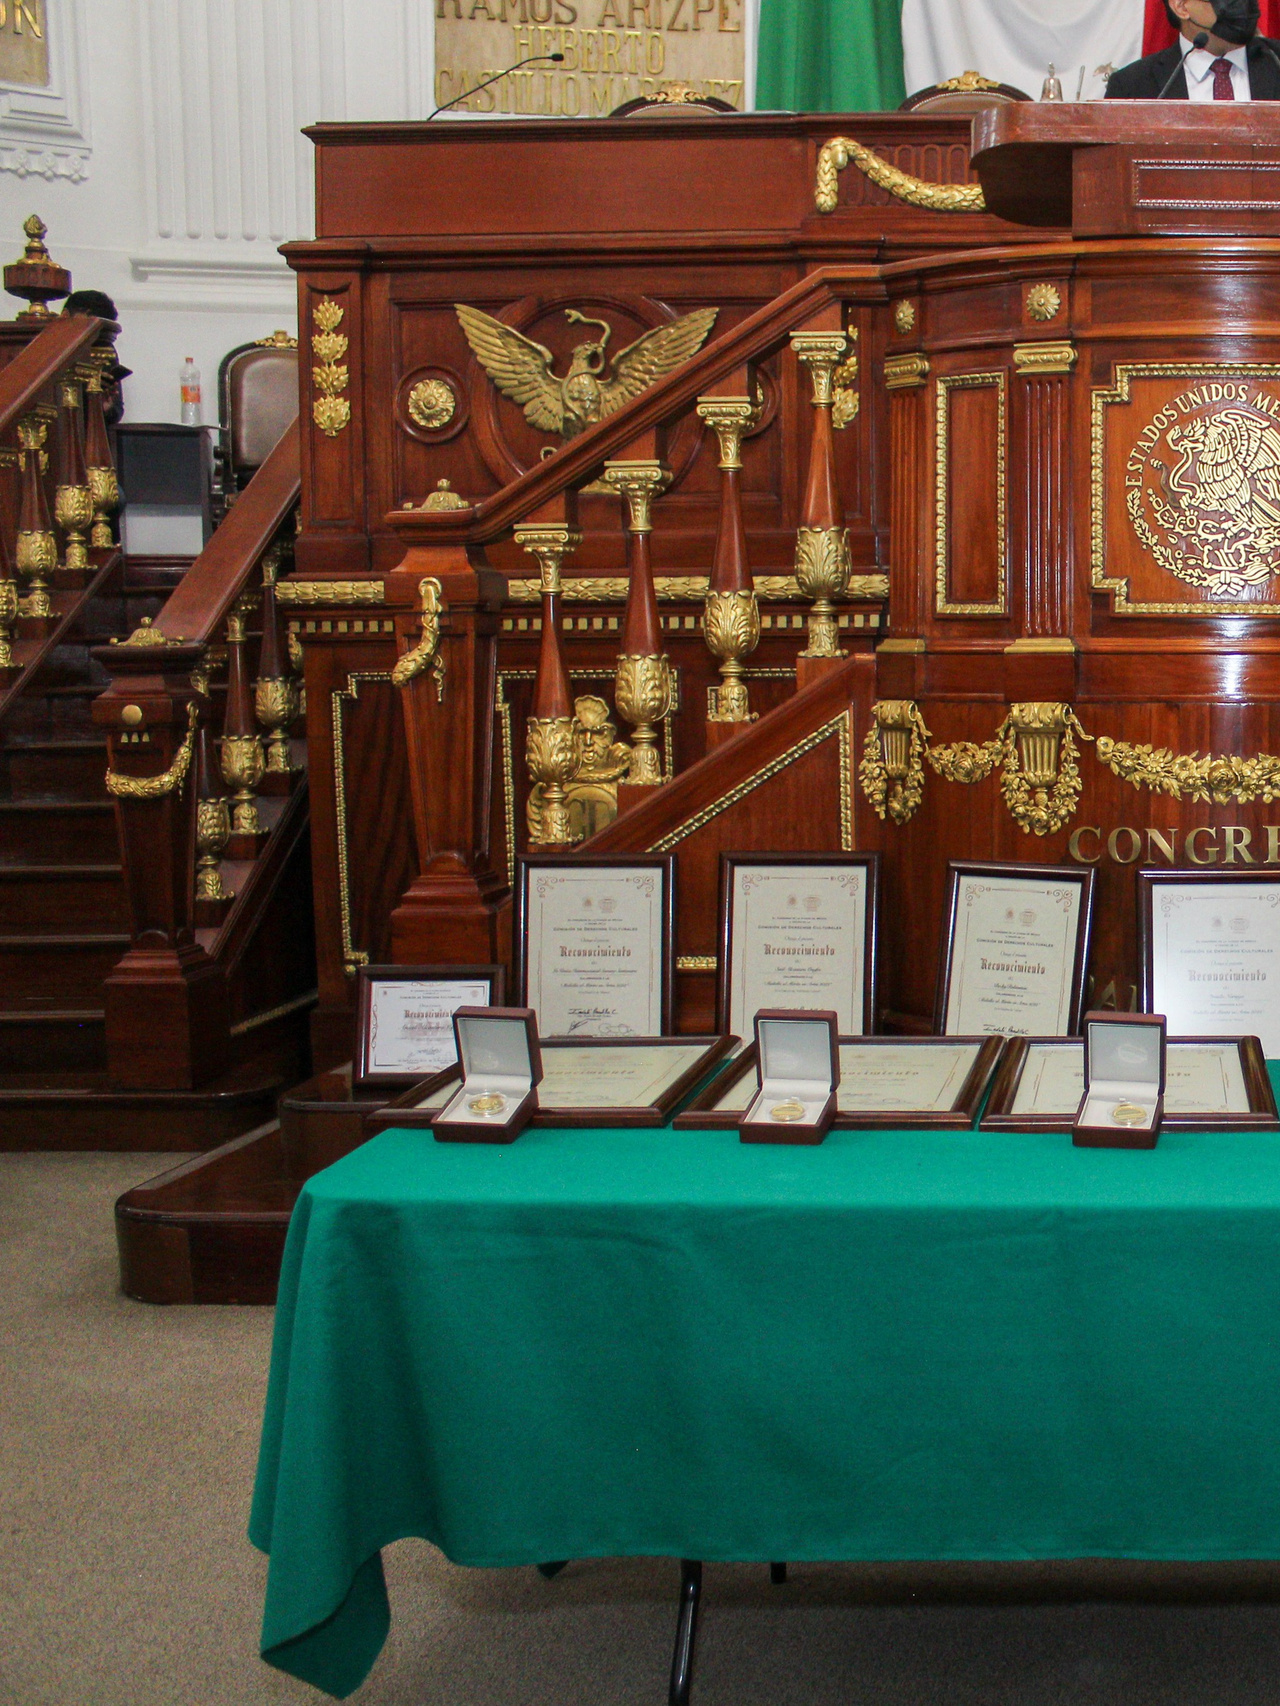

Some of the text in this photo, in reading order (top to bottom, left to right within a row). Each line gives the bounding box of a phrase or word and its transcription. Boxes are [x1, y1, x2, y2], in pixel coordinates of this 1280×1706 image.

[513, 24, 665, 75] HEBERTO
[434, 67, 580, 117] CASTILLO
[1125, 402, 1179, 487] ESTADOS
[1174, 382, 1250, 415] UNIDOS
[559, 945, 631, 957] Reconocimiento
[763, 943, 835, 956] Reconocimiento
[980, 957, 1046, 975] Reconocimiento
